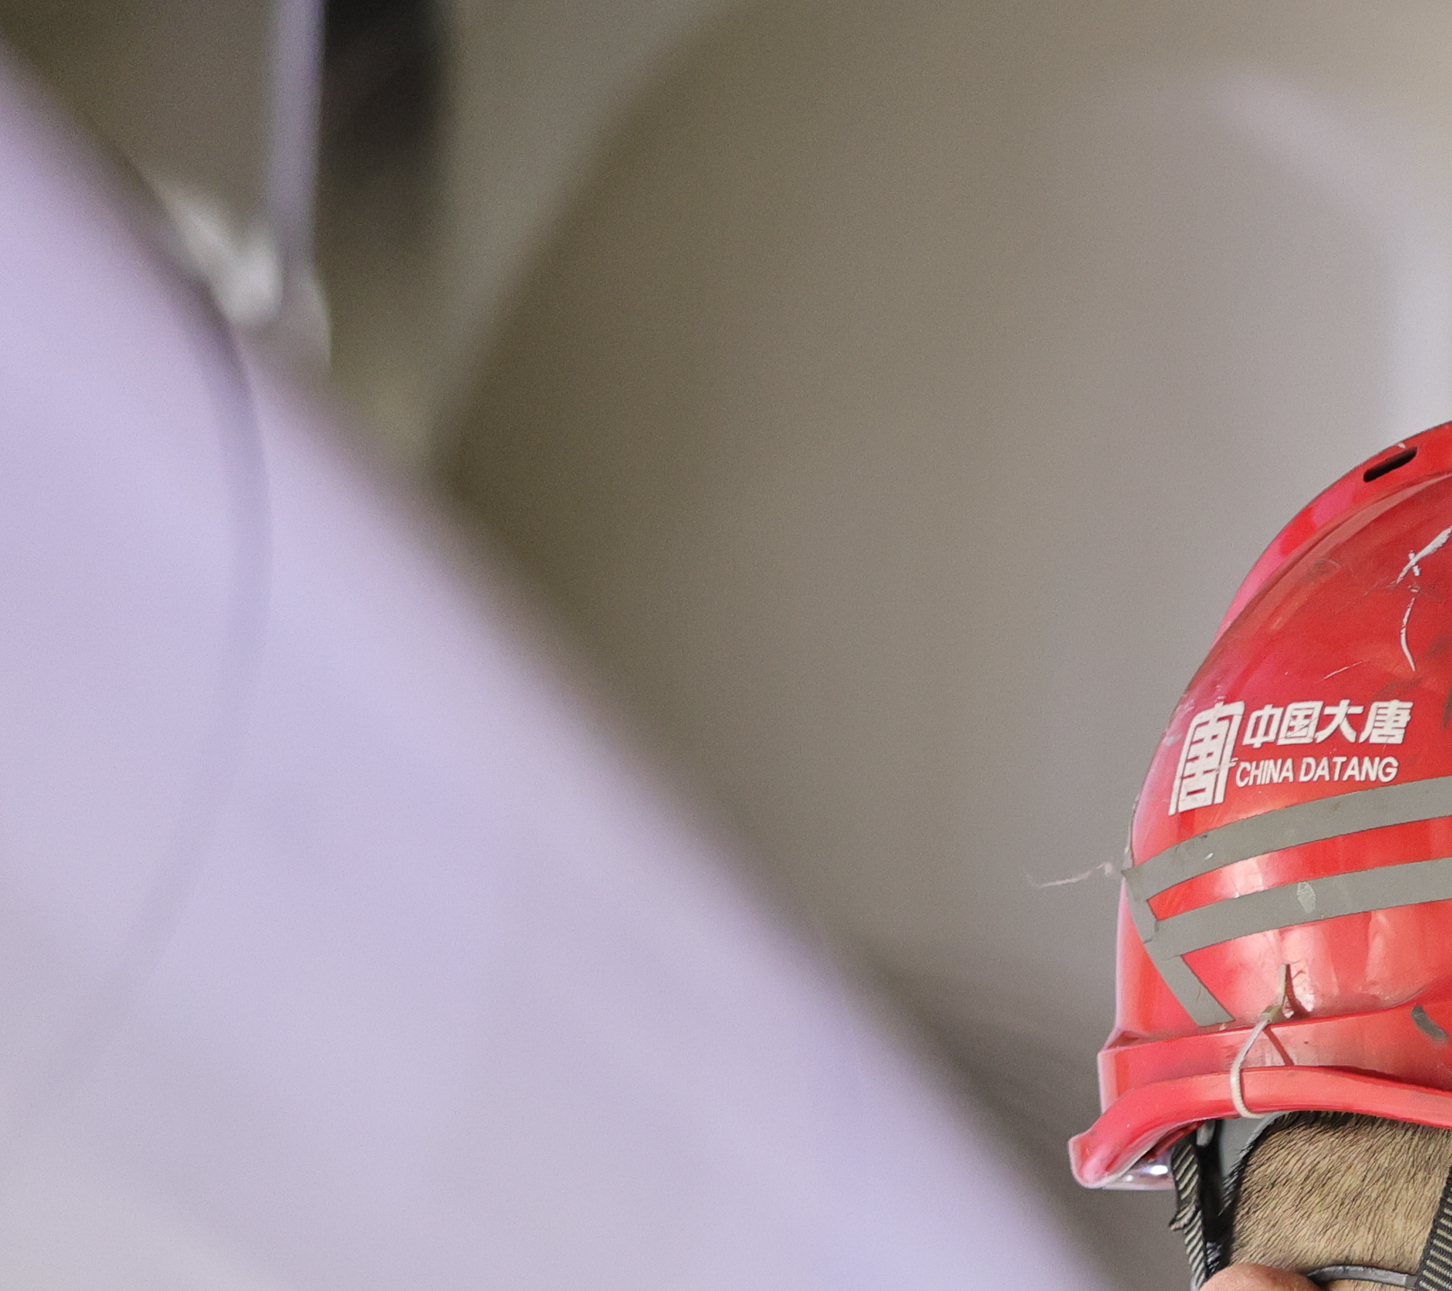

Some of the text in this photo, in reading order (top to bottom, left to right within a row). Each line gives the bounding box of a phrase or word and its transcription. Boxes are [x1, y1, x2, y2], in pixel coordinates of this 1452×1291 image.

[1242, 699, 1414, 748] 中国大唐
[1235, 756, 1400, 788] CHINA DATANG
